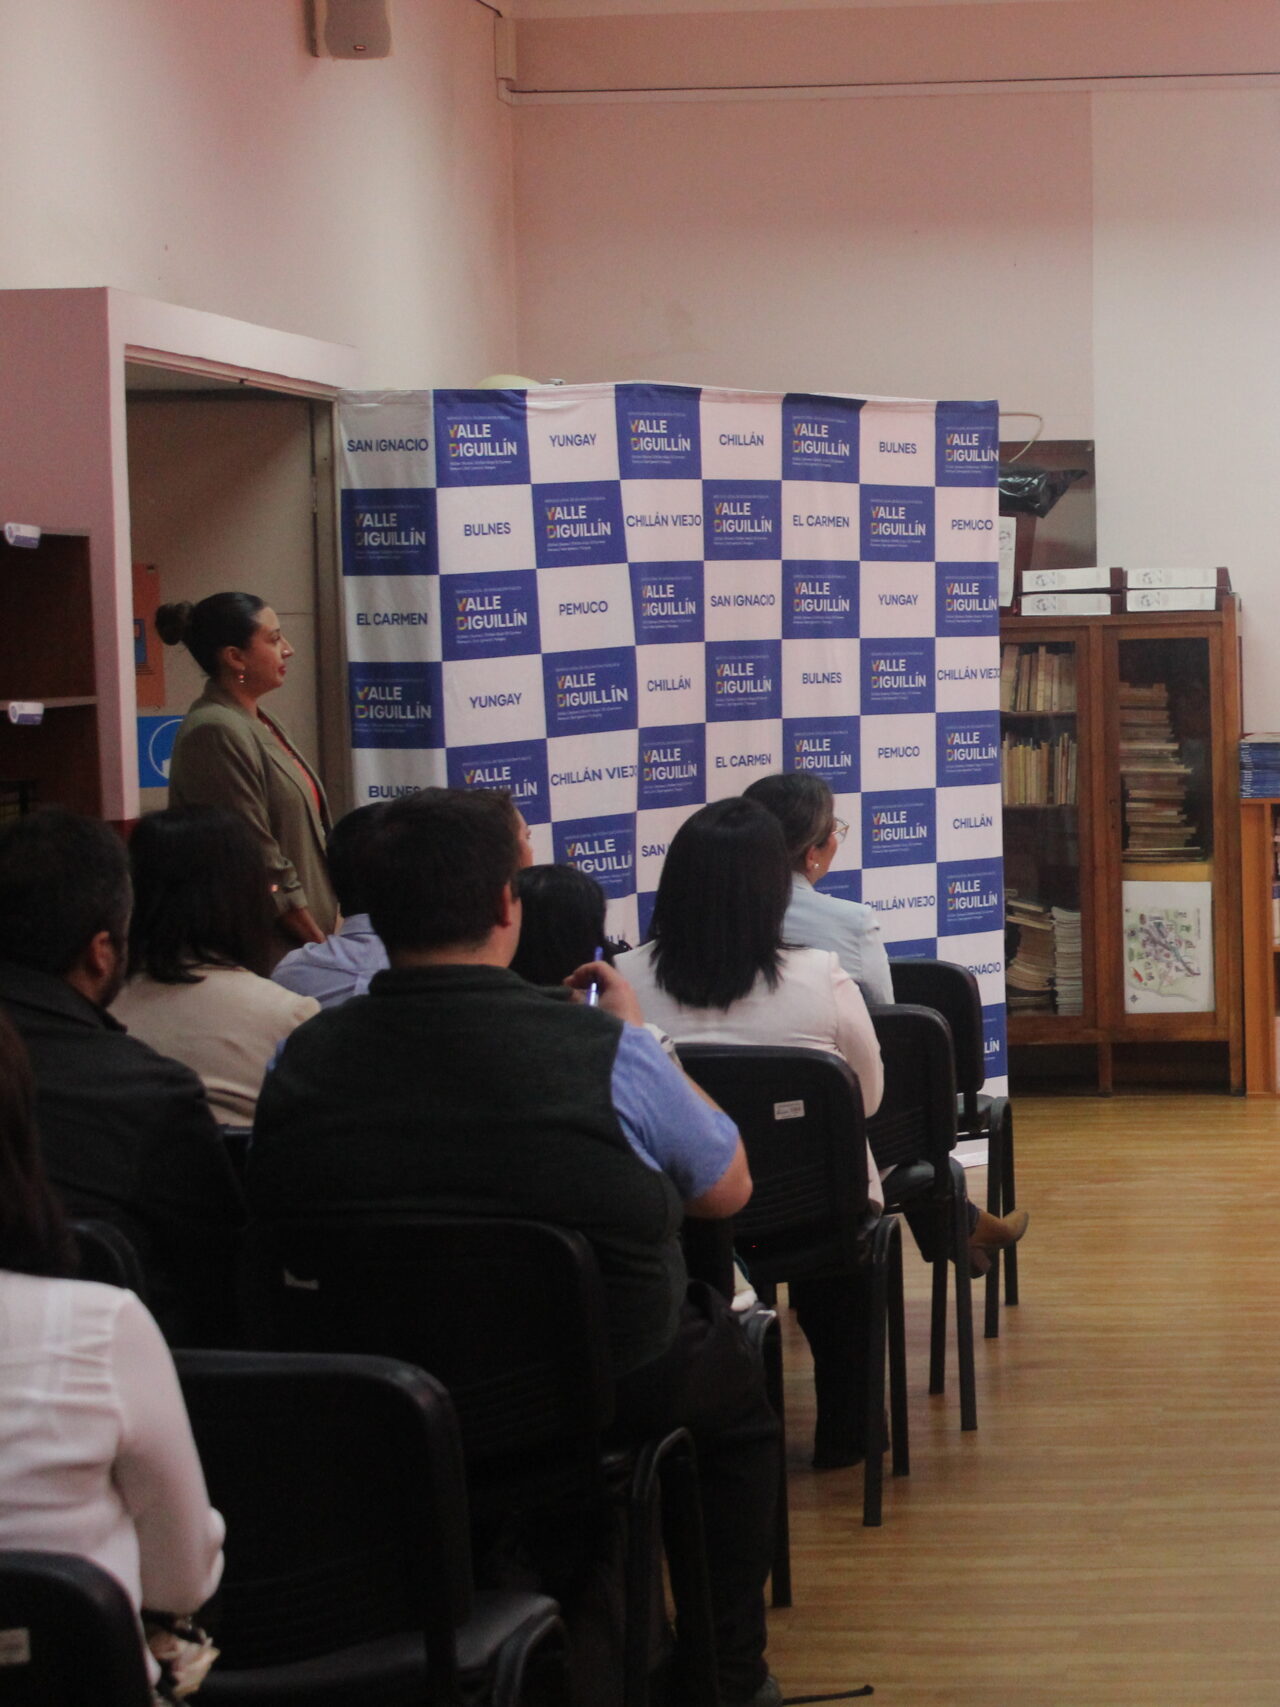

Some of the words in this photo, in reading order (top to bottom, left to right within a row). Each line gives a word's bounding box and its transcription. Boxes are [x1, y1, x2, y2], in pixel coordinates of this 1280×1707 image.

[448, 423, 492, 439] VALLE
[630, 419, 667, 434] VALLE
[793, 423, 829, 438] VALLE
[346, 439, 373, 453] SAN
[375, 438, 429, 452] IGNACIO
[549, 433, 597, 448] YUNGAY
[631, 434, 691, 452] DIGUILLÍN
[719, 431, 764, 447] CHILLÁN
[945, 432, 979, 447] VALLE
[448, 440, 518, 458] DIGUILLÍN
[792, 439, 850, 457] DIGUILLÍN
[879, 441, 917, 455] BULNES
[945, 448, 999, 463] DIGUILLÍN
[546, 505, 587, 521] VALLE
[713, 502, 751, 516] VALLE
[870, 506, 908, 519] VALLE
[356, 513, 397, 528] VALLE
[626, 512, 669, 528] CHILLÁN
[671, 514, 702, 527] VIEJO
[713, 516, 773, 534] DIGUILLÍN
[792, 514, 804, 527] EL
[806, 515, 850, 529] CARMEN
[870, 519, 926, 536] DIGUILLÍN
[951, 519, 993, 531] PEMUCO
[355, 527, 427, 546] DIGUILLÍN
[463, 522, 512, 537] BULNES
[546, 519, 612, 539] DIGUILLÍN
[793, 582, 830, 596] VALLE
[945, 582, 979, 596] VALLE
[456, 595, 502, 612] VALLE
[558, 600, 608, 617] PEMUCO
[710, 594, 731, 608] SAN
[732, 594, 775, 608] IGNACIO
[793, 595, 850, 613] DIGUILLÍN
[878, 594, 918, 608] YUNGAY
[945, 595, 998, 613] DIGUILLÍN
[356, 614, 371, 627] EL
[373, 613, 428, 627] CARMEN
[456, 609, 528, 631] DIGUILLÍN
[715, 662, 754, 678] VALLE
[871, 658, 907, 672] VALLE
[936, 665, 977, 681] CHILLÁN
[556, 672, 596, 690] VALLE
[647, 675, 691, 693] CHILLÁN
[715, 676, 772, 695] DIGUILLÍN
[802, 671, 842, 686] BULNES
[871, 672, 927, 690] DIGUILLÍN
[355, 686, 402, 701] VALLE
[469, 692, 522, 710] YUNGAY
[556, 685, 628, 708] DIGUILLÍN
[355, 700, 432, 720] DIGUILLÍN
[794, 738, 831, 753] VALLE
[946, 731, 980, 747] VALLE
[643, 747, 681, 764] VALLE
[715, 755, 726, 768] EL
[729, 753, 771, 767] CARMEN
[794, 750, 852, 770] DIGUILLÍN
[877, 745, 920, 760] PEMUCO
[946, 744, 998, 762] DIGUILLÍN
[463, 766, 511, 785] VALLE
[550, 766, 602, 786] CHILLÁN
[643, 760, 698, 782] DIGUILLÍN
[872, 810, 907, 826] VALLE
[952, 815, 993, 830] CHILLÁN
[872, 824, 928, 842] DIGUILLÍN
[565, 838, 616, 857] VALLE
[641, 844, 666, 858] SAN
[947, 879, 981, 895] VALLE
[907, 895, 936, 908] VIEJO
[947, 891, 998, 910] DIGUILLÍN
[964, 961, 1001, 976] GNACIO
